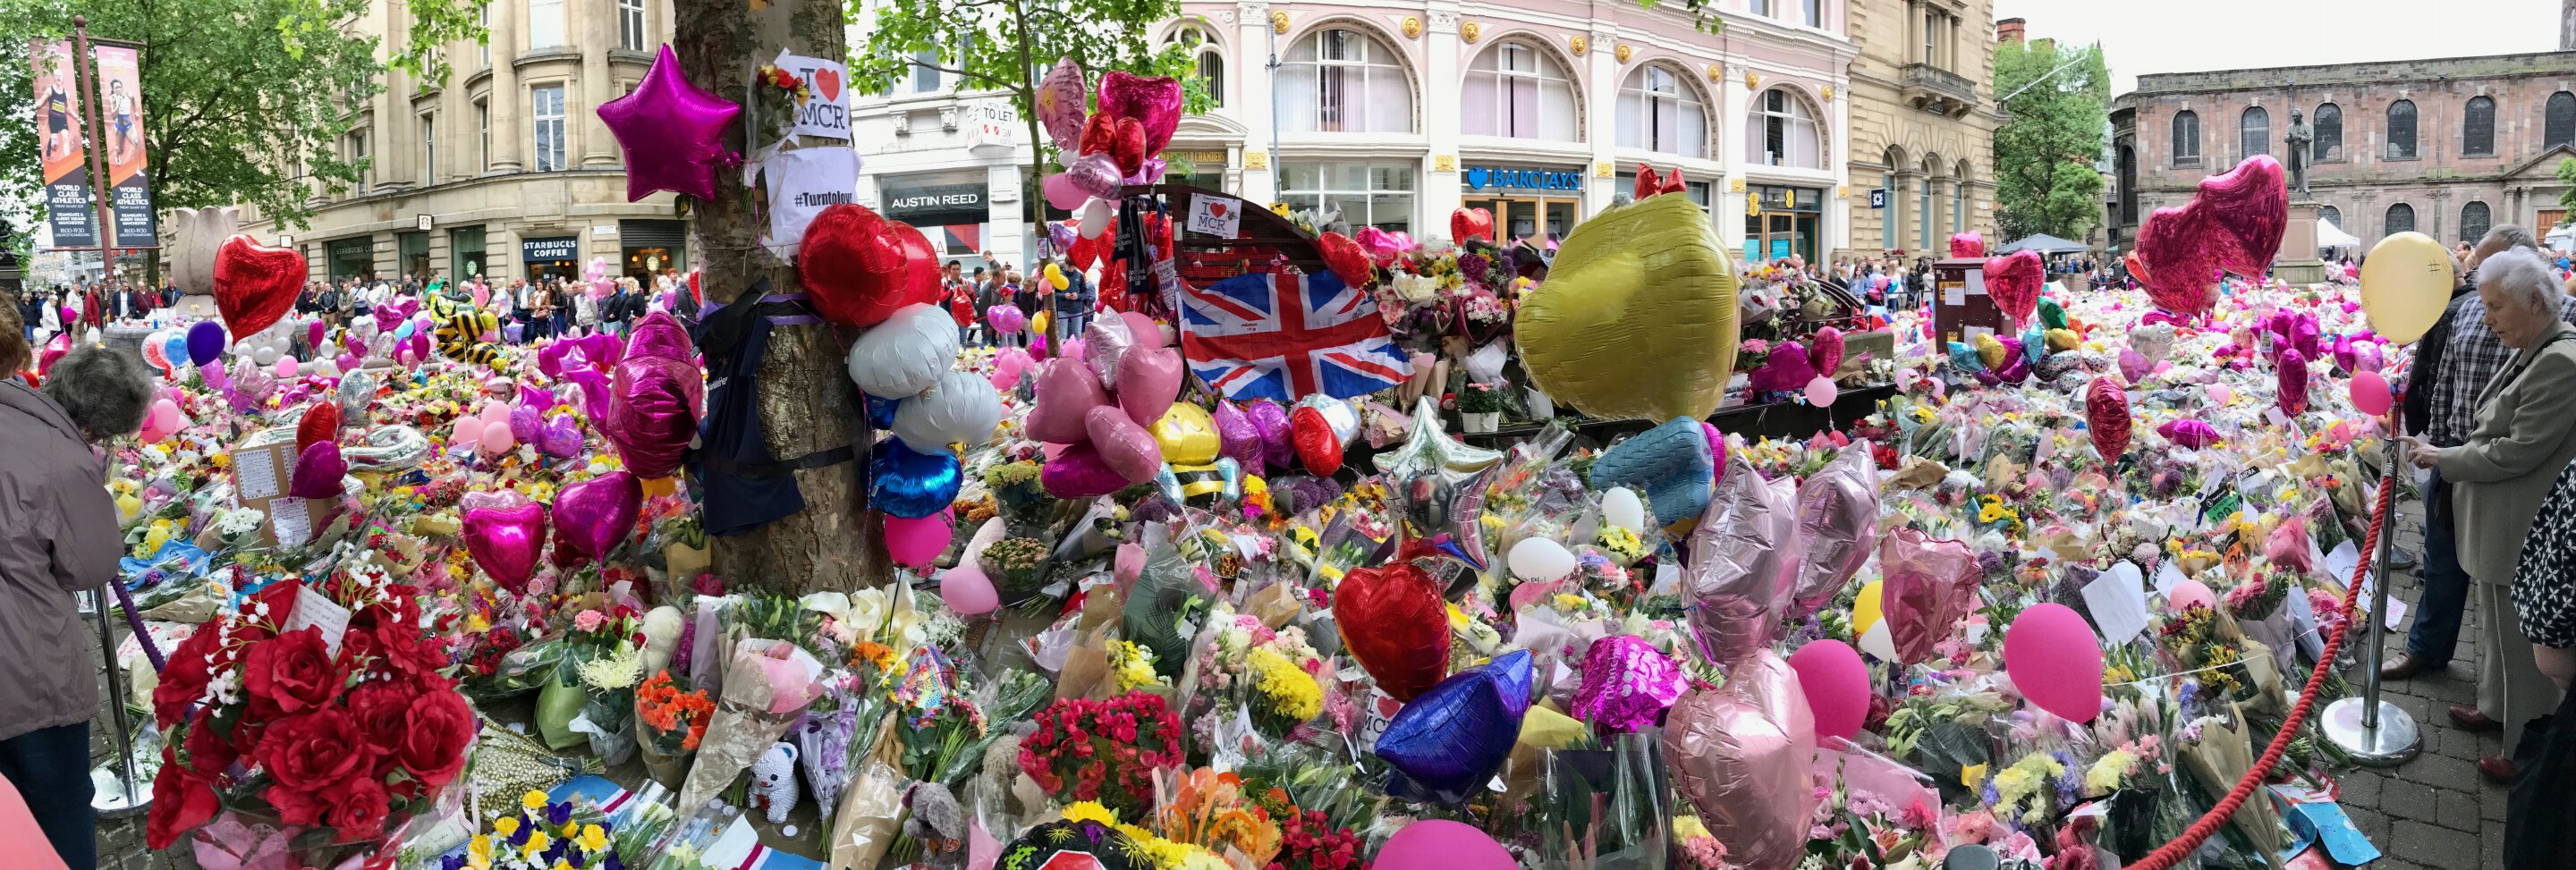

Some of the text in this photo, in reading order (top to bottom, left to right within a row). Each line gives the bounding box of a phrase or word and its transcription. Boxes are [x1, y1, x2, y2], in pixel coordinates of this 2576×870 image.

[800, 68, 816, 99] I
[801, 103, 845, 130] MCR
[984, 107, 996, 119] TO
[998, 110, 1013, 122] LET
[1194, 151, 1224, 162] CHAMBERS
[1492, 169, 1580, 190] BARCLAYS
[892, 193, 978, 208] AUSTIN REED
[1200, 202, 1210, 215] I
[1198, 215, 1225, 231] MCR
[523, 241, 576, 249] STARBUCKS
[534, 249, 568, 258] COFFEE
[2152, 556, 2166, 579] CLAIRE
[1362, 714, 1391, 734] MC
